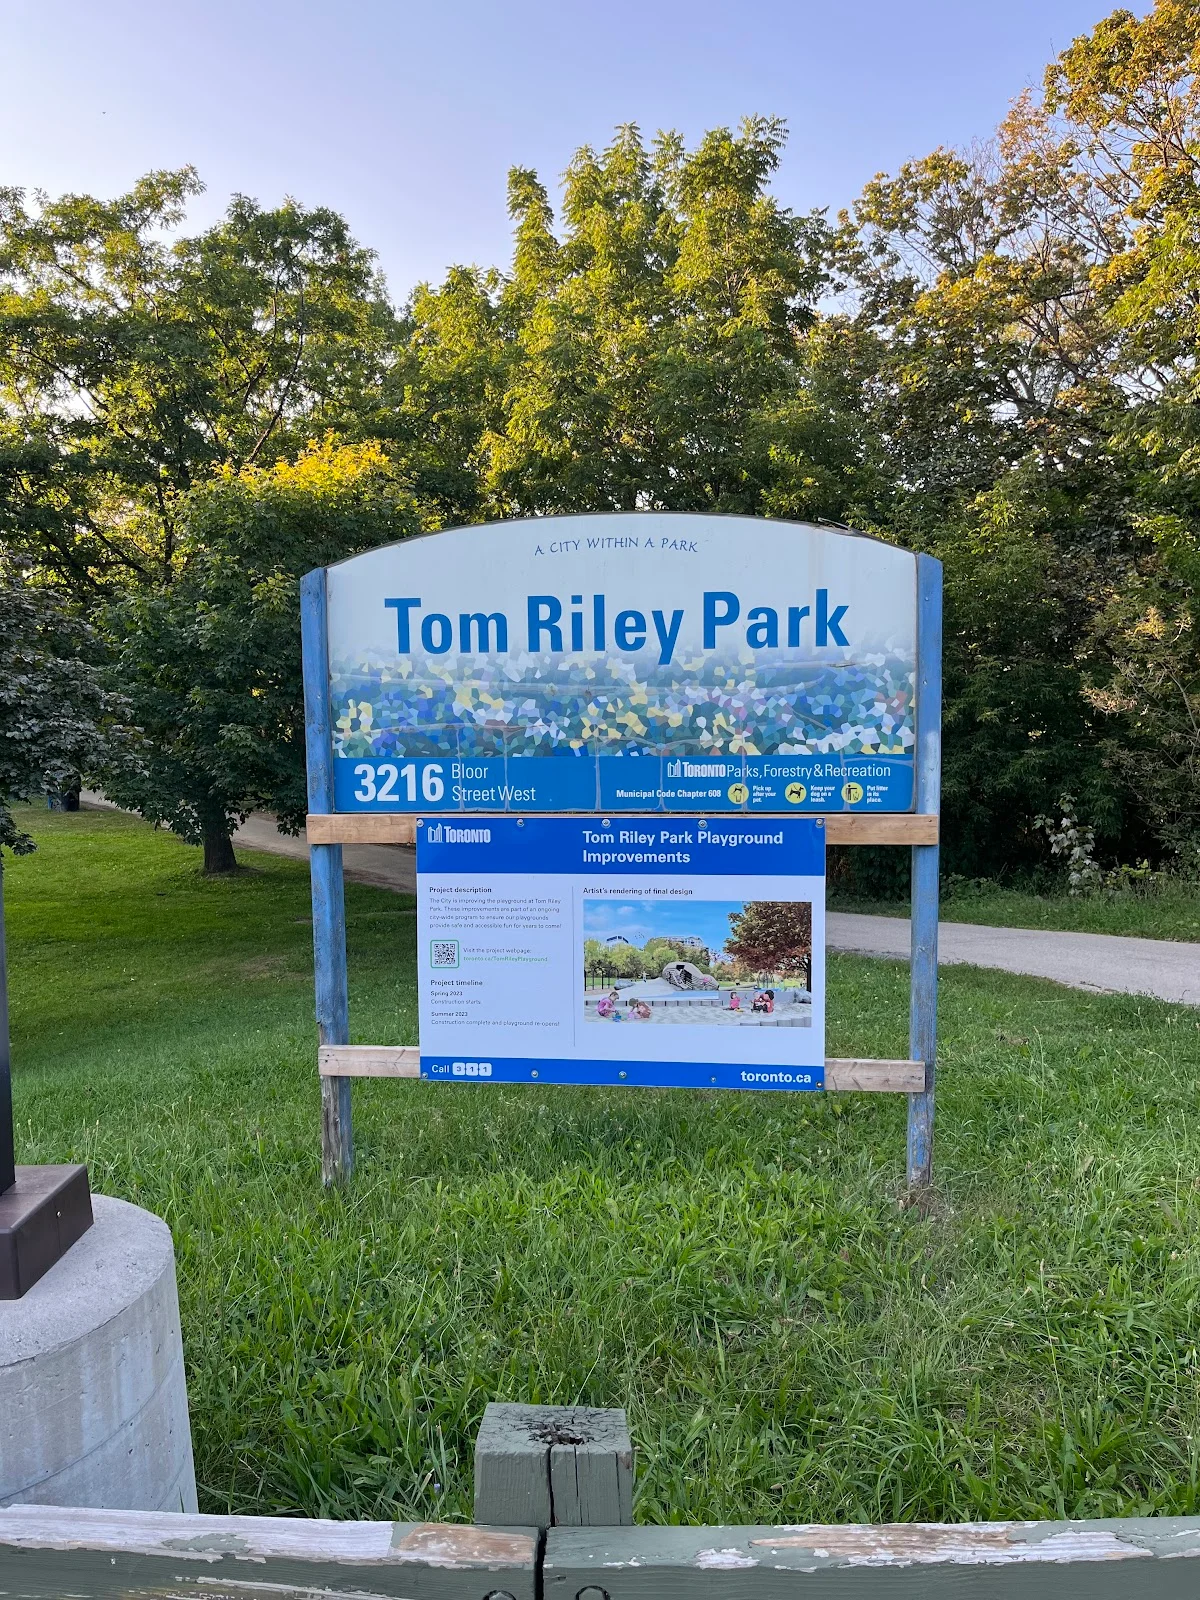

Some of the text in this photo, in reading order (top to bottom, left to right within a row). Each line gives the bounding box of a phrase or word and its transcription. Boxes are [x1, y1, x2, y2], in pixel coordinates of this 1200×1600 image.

[534, 537, 698, 556] A CITY WITHIN A PARK
[384, 589, 851, 665] Tom Riley Park
[452, 764, 488, 779] Bloor
[682, 764, 891, 780] TORONTO Parks, Forestry & Recreation
[354, 764, 445, 801] 3216
[452, 786, 536, 801] Street West
[616, 789, 721, 799] Municipal Code Chapter 608
[444, 827, 491, 843] TORONTO
[583, 831, 783, 848] Tom Riley Park Playground
[583, 851, 690, 866] Improvements
[609, 888, 642, 897] rendering
[671, 888, 693, 897] design
[432, 1065, 449, 1073] Call
[741, 1071, 811, 1083] toronto.ca
